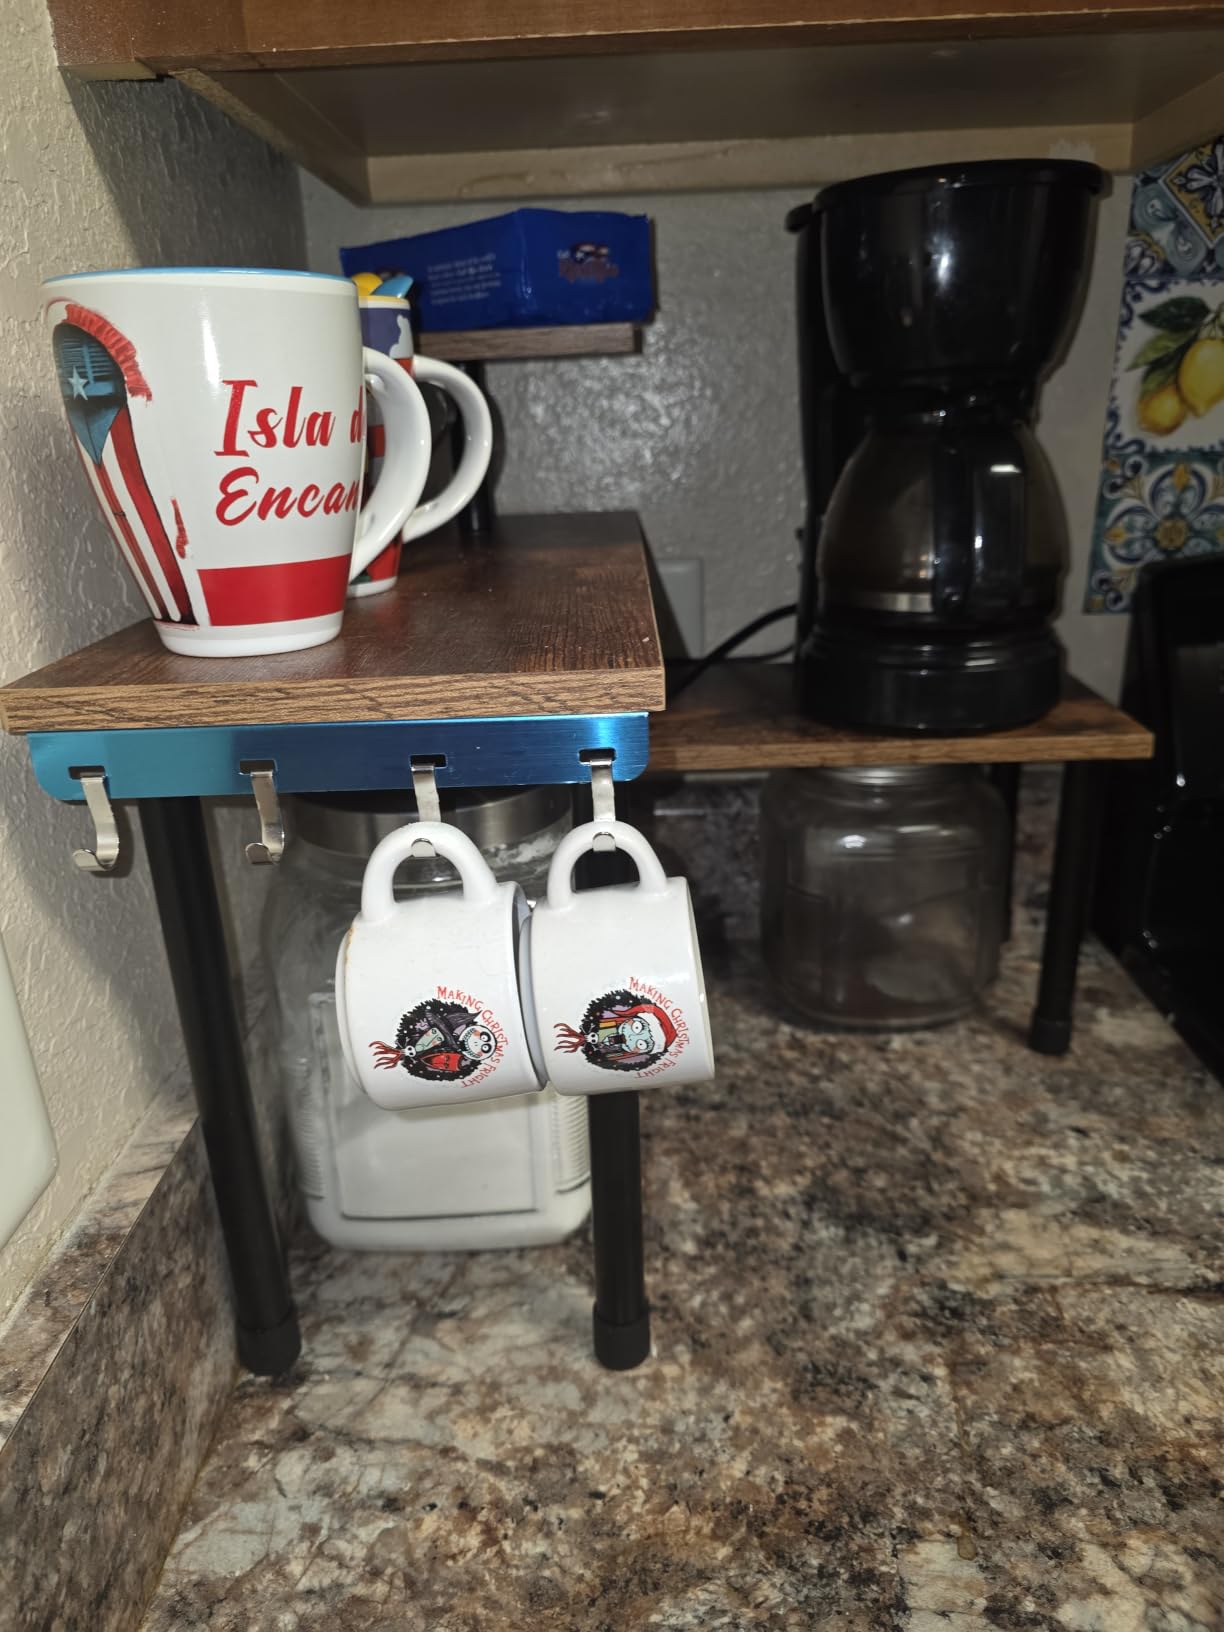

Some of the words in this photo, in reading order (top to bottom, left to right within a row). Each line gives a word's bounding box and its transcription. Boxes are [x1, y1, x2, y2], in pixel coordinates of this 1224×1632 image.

[214, 380, 336, 457] Isla
[437, 986, 484, 1011] MAKING
[481, 1009, 508, 1064] CHRISTMAS
[629, 976, 673, 1010] MAKING
